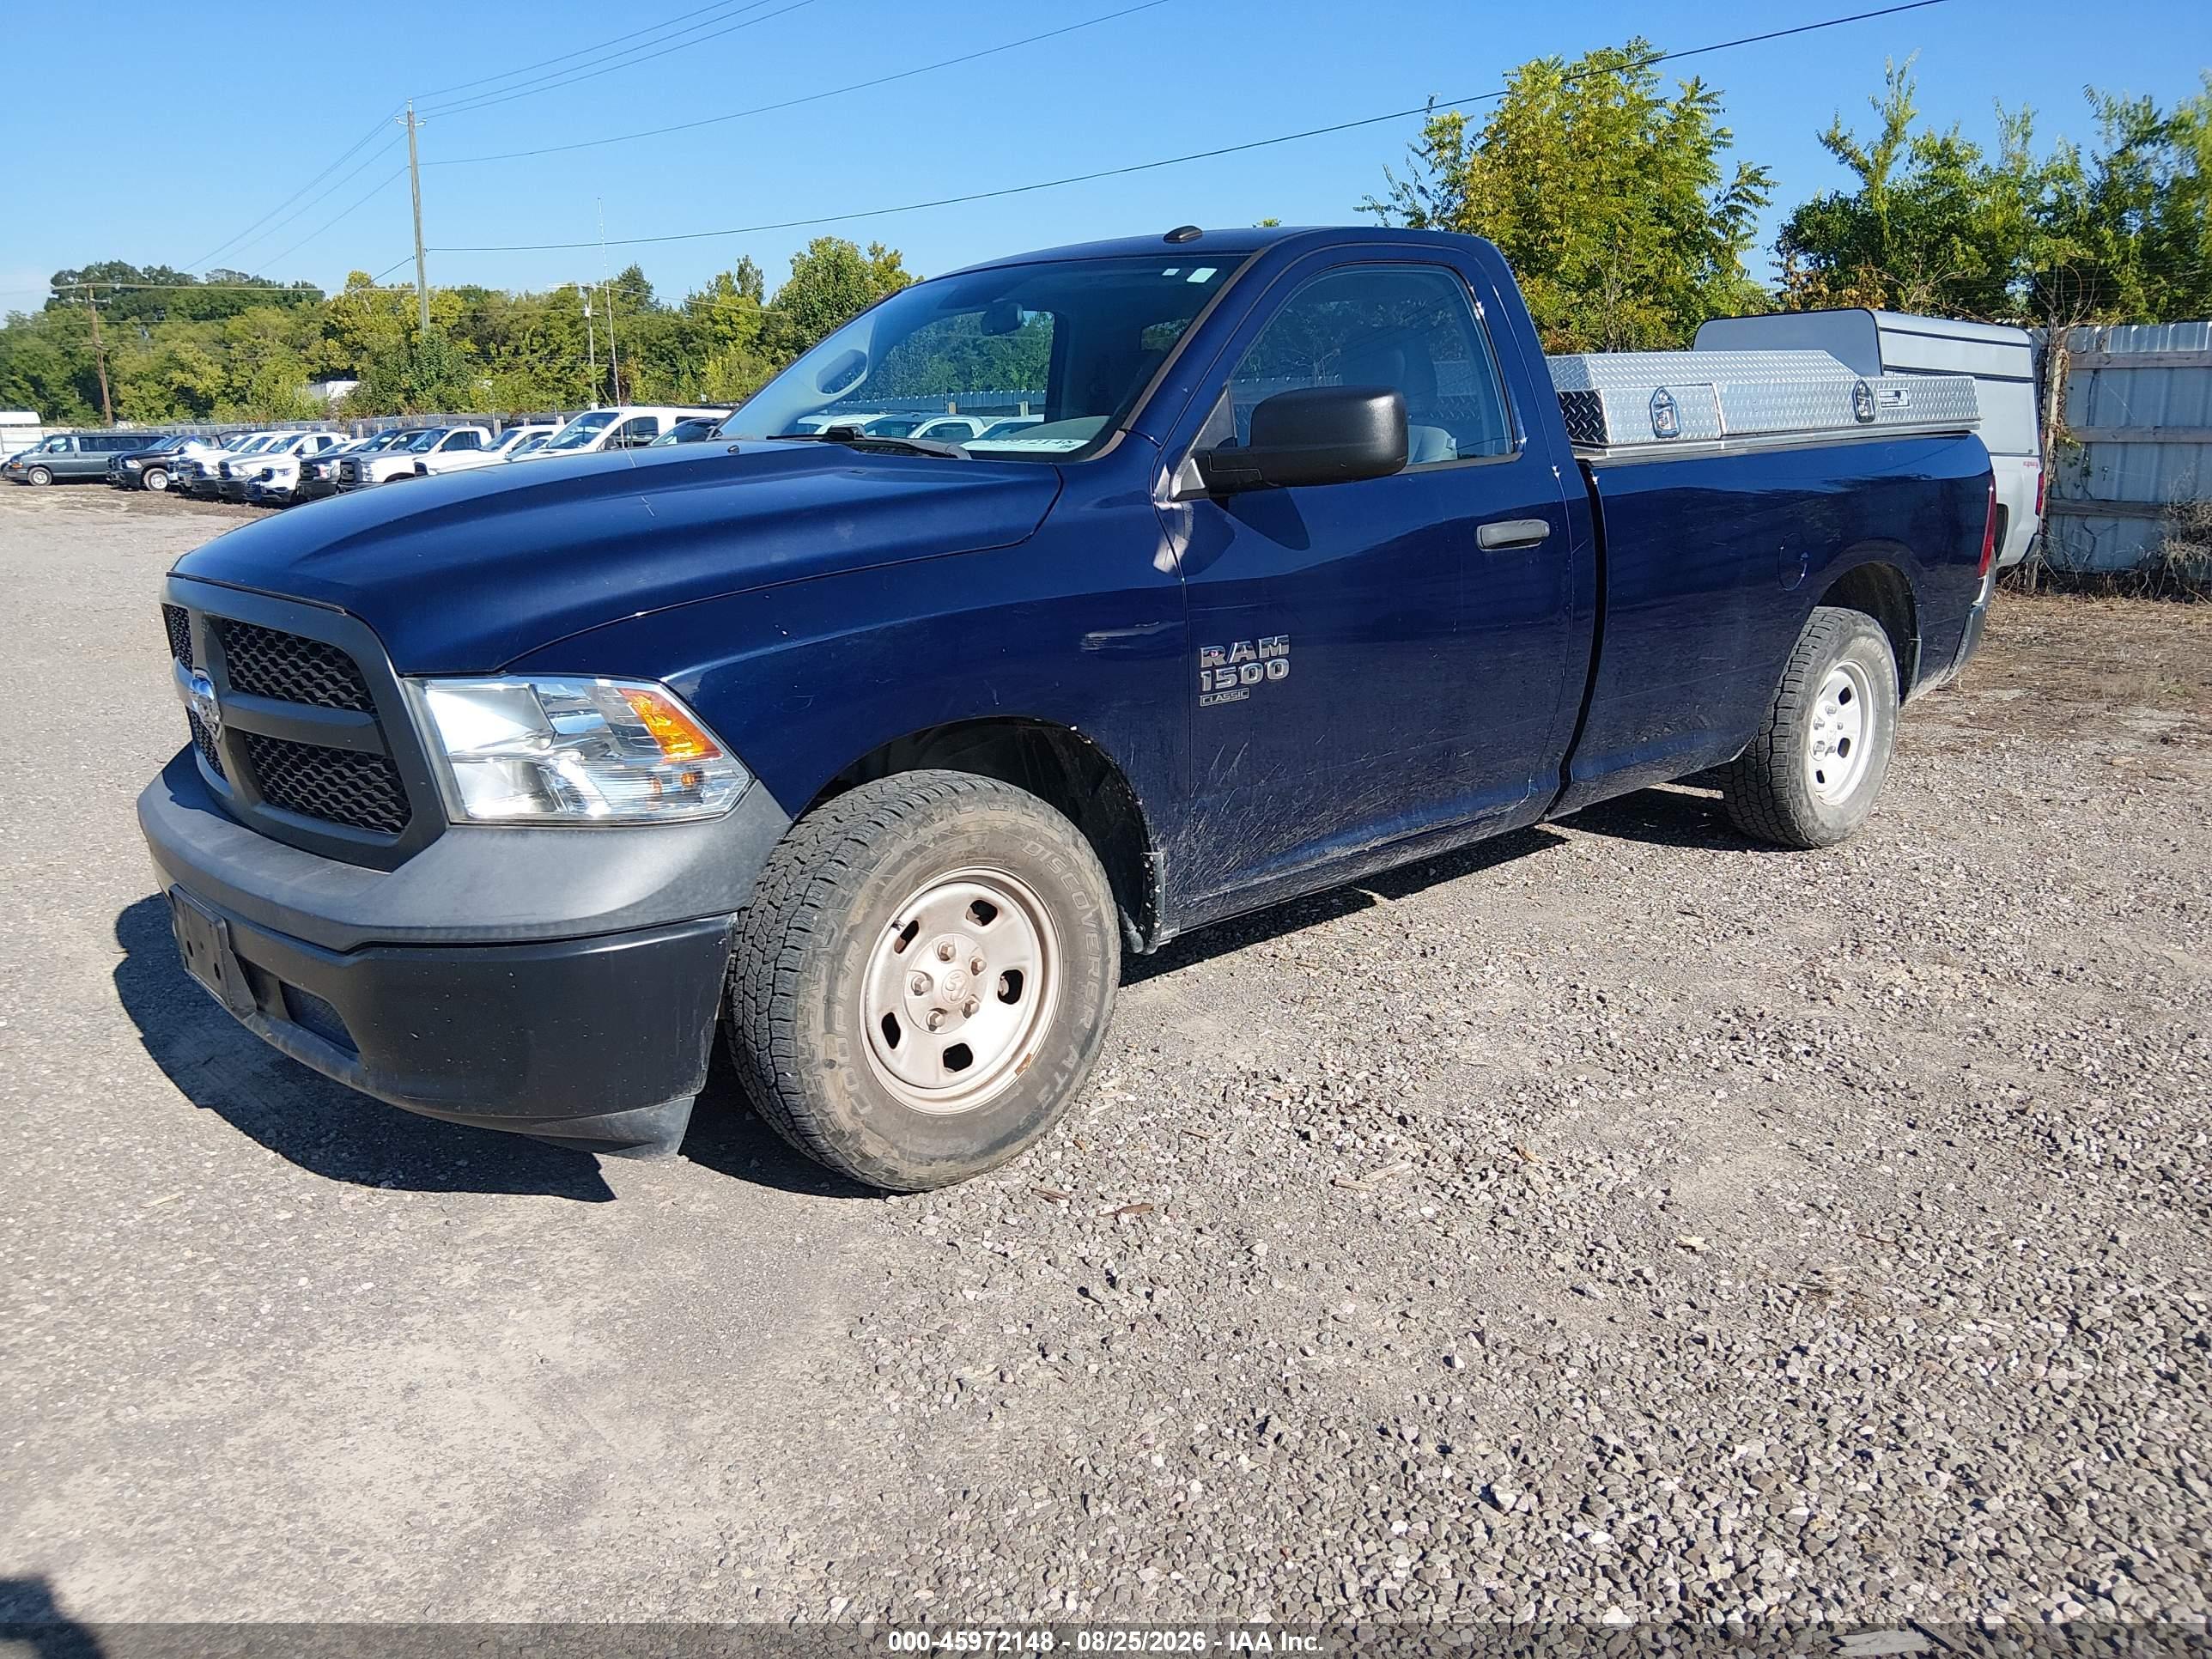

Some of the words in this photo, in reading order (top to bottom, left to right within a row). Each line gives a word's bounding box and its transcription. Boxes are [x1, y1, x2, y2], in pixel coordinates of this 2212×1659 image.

[1200, 634, 1289, 668] RAM
[1200, 658, 1290, 692] 1500
[1202, 690, 1249, 704] CLASSIC
[1022, 839, 1101, 1030] DISCOVERER
